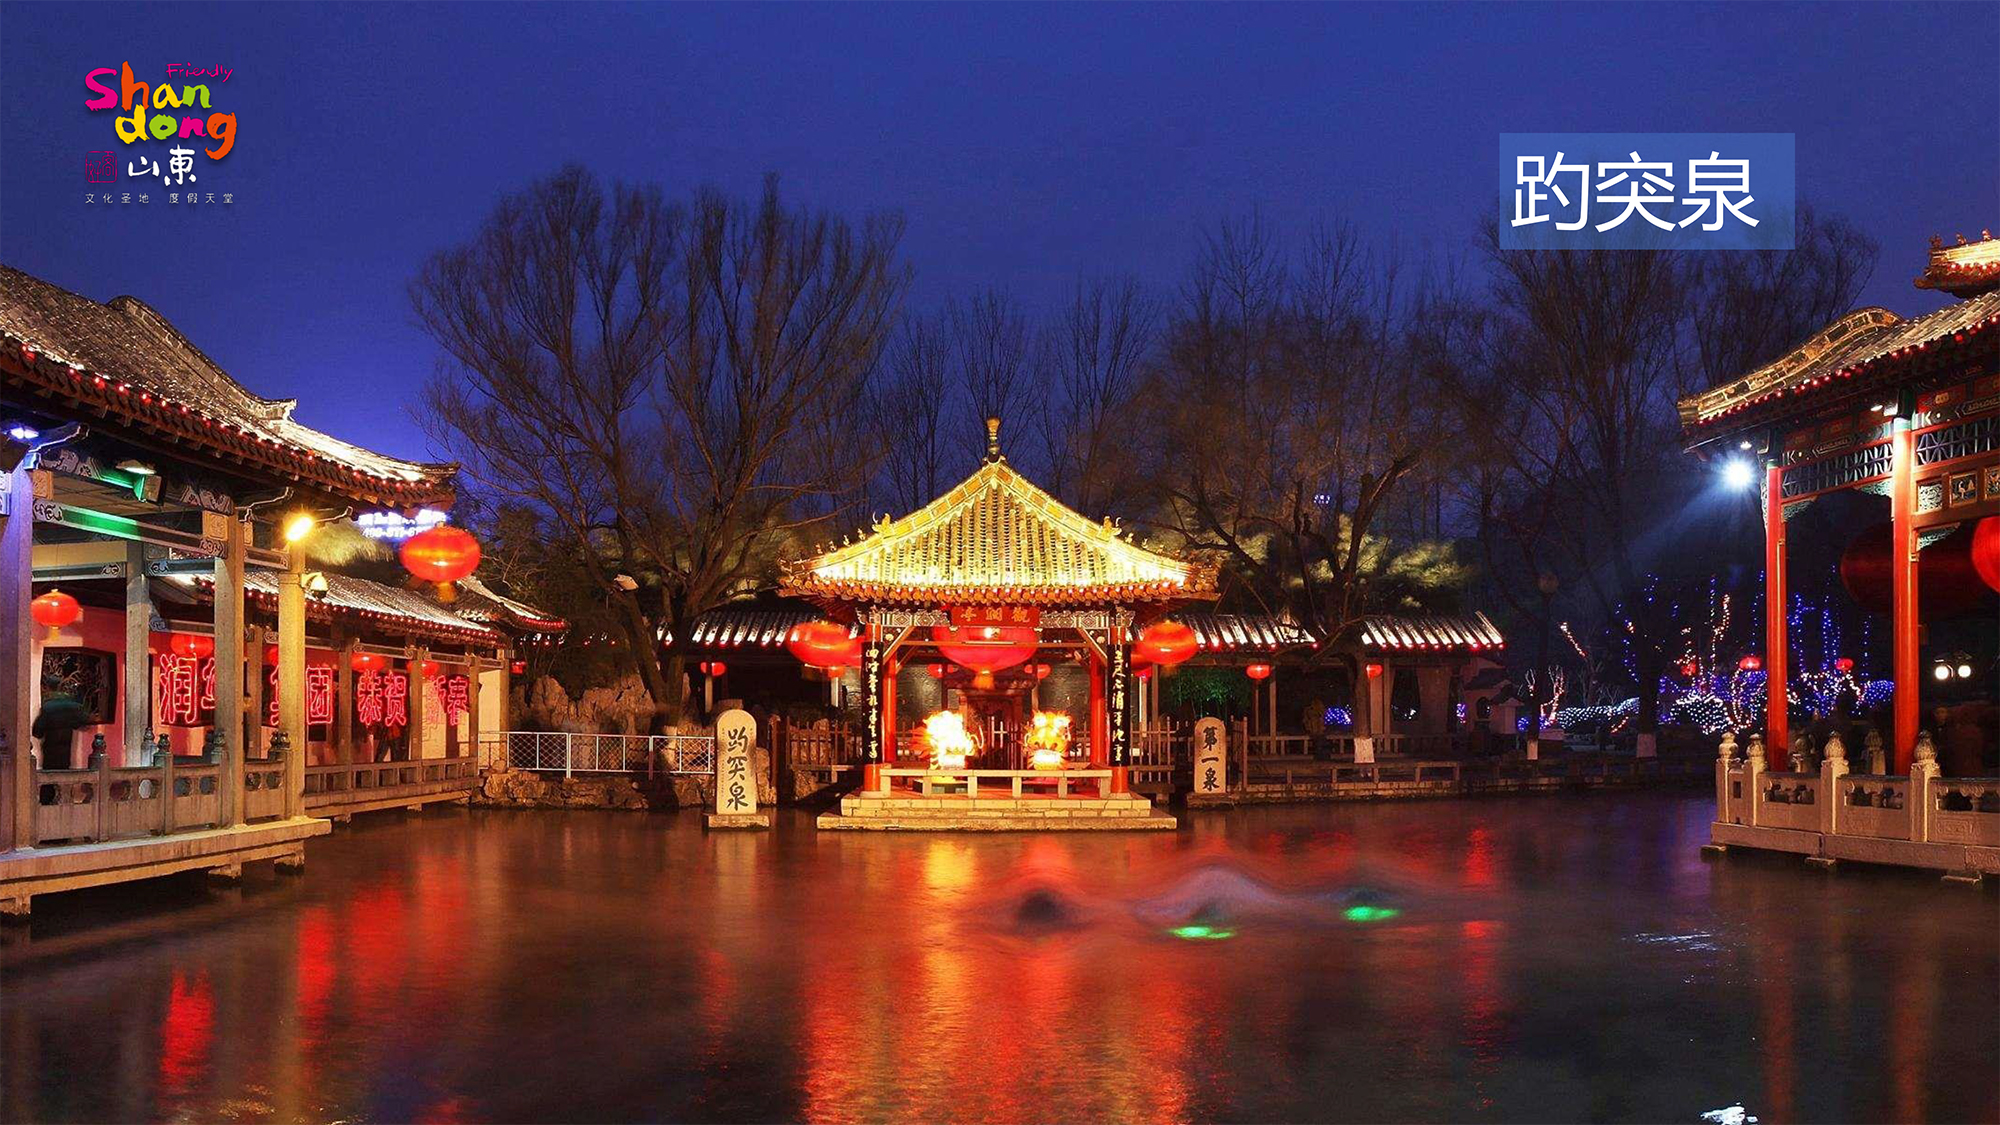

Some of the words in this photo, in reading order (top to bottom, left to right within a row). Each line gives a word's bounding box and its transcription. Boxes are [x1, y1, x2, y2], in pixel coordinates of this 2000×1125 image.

[727, 726, 749, 811] 趵突泉
[1201, 726, 1220, 791] 第一泉
